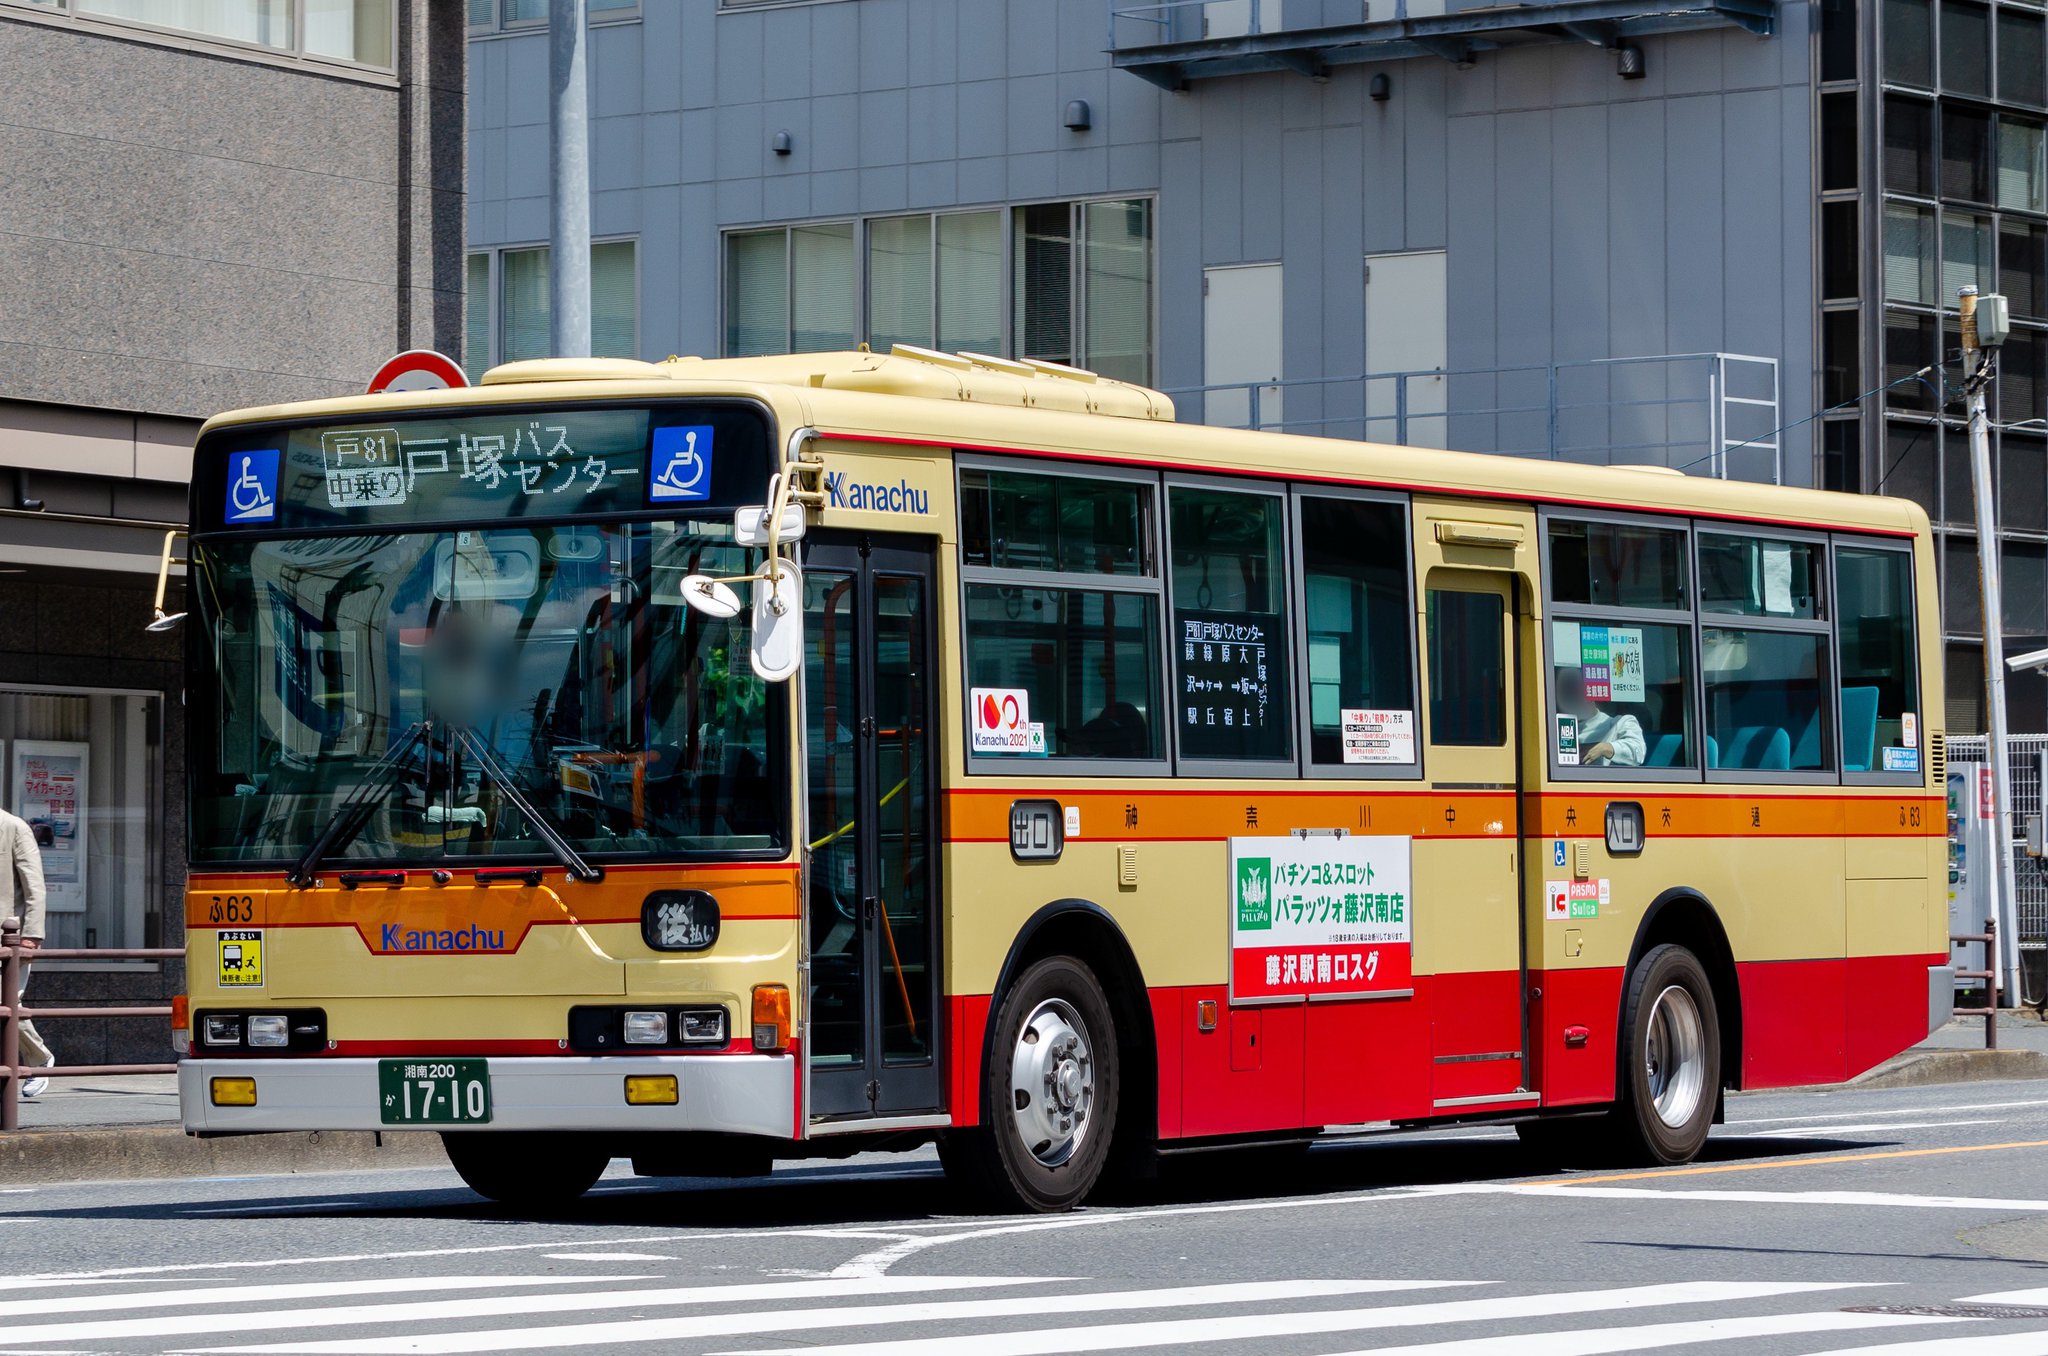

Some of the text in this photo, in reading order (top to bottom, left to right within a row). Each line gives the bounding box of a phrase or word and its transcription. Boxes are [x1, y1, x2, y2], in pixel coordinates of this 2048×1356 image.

[334, 436, 388, 467] 戸81
[512, 422, 575, 458] バス
[402, 433, 509, 493] 戸塚
[512, 455, 639, 494] センター
[329, 471, 401, 502] 中乗り
[828, 471, 928, 514] Kanachu
[975, 733, 1028, 746] Kanachu 2021
[1561, 725, 1575, 738] NBA
[1014, 811, 1049, 849] 出口
[1125, 803, 1761, 830] 神 奈 川 中 央 交 通
[1608, 811, 1633, 844] 入口
[1571, 884, 1597, 897] PASMO
[209, 896, 253, 922] ふ63
[658, 903, 715, 945] 後払い
[1241, 909, 1268, 922] PALAZZO
[1275, 892, 1405, 925] パラッツォ藤沢南店
[223, 932, 255, 940] あぶない
[382, 923, 504, 950] Kanachu
[1266, 951, 1379, 986] 藤沢駅南口スグ
[385, 1080, 484, 1119] か 17-10
